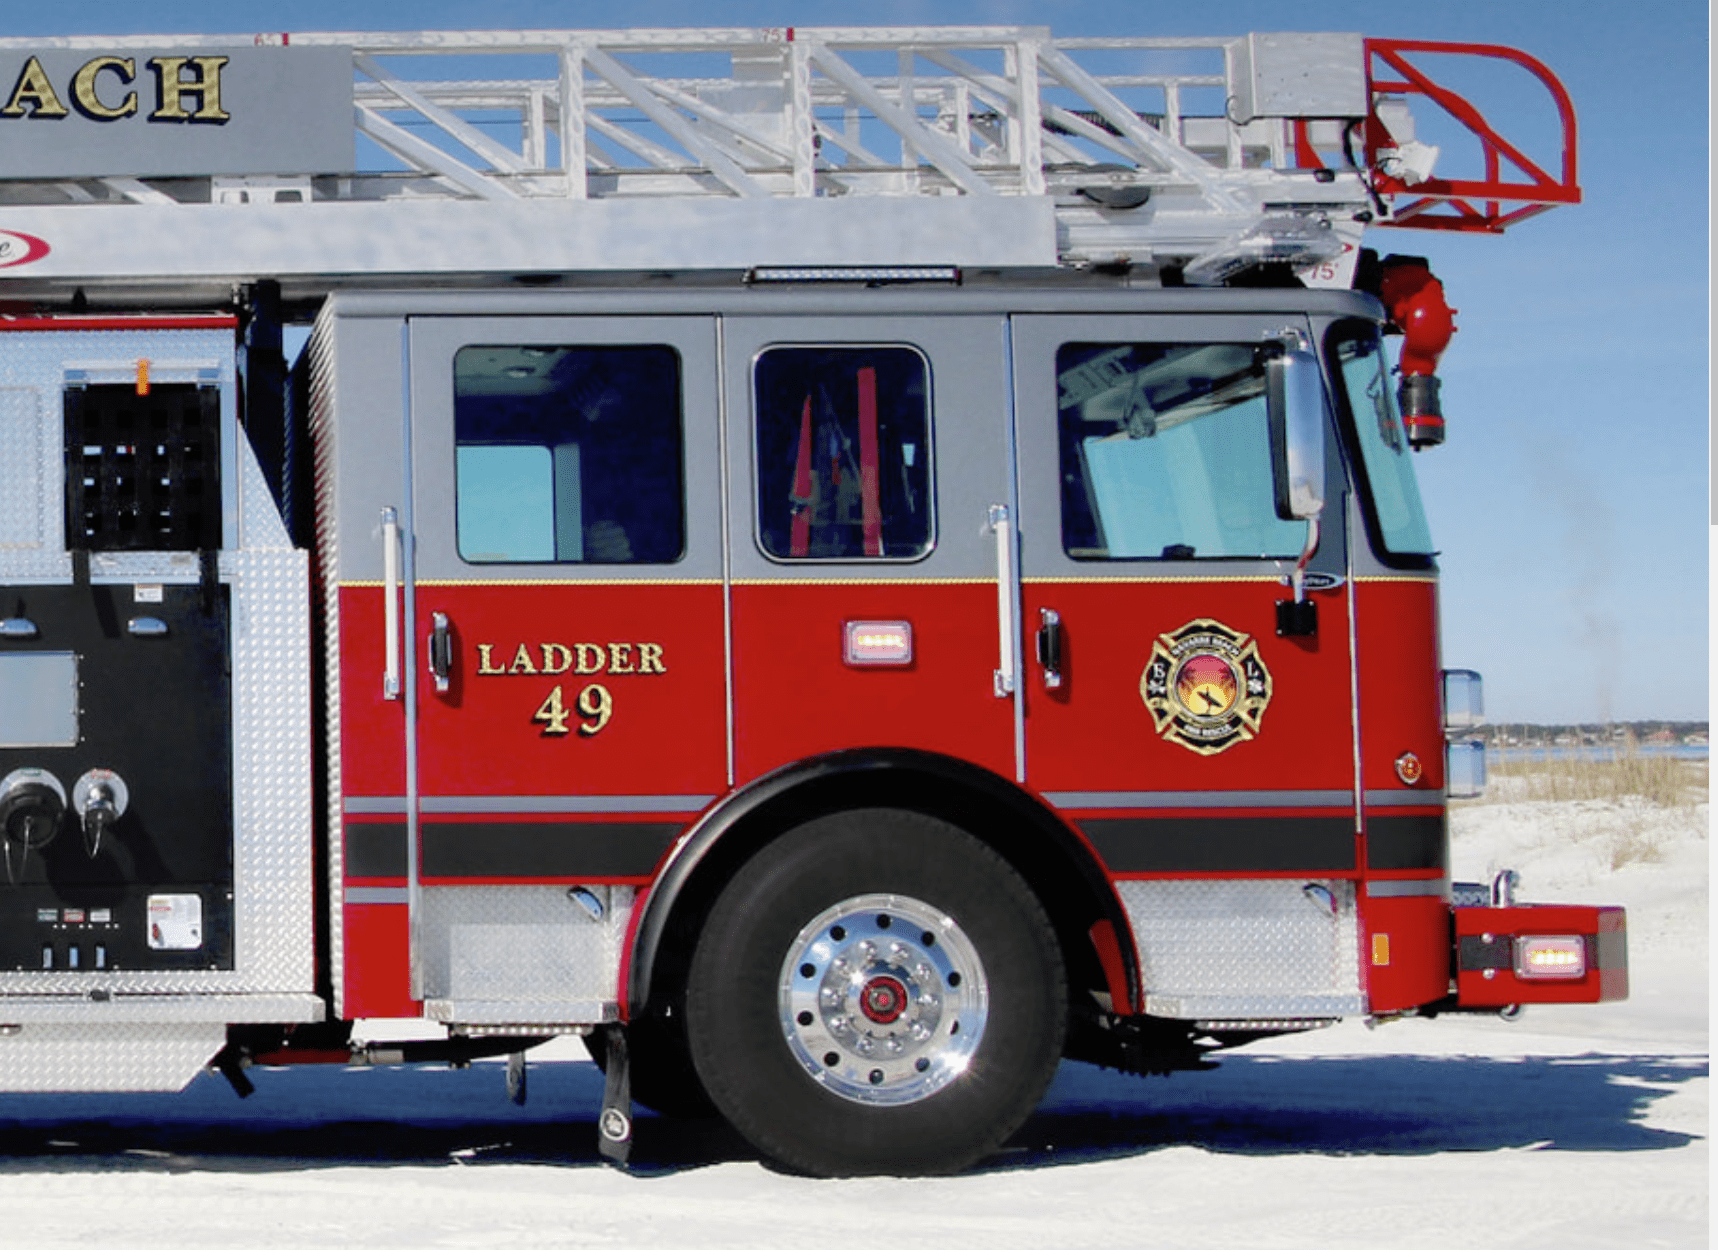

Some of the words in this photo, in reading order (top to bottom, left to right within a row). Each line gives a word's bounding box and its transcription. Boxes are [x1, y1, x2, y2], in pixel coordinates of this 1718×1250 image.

[0, 55, 231, 125] ACH
[477, 643, 667, 674] LADDER
[532, 683, 613, 737] 49
